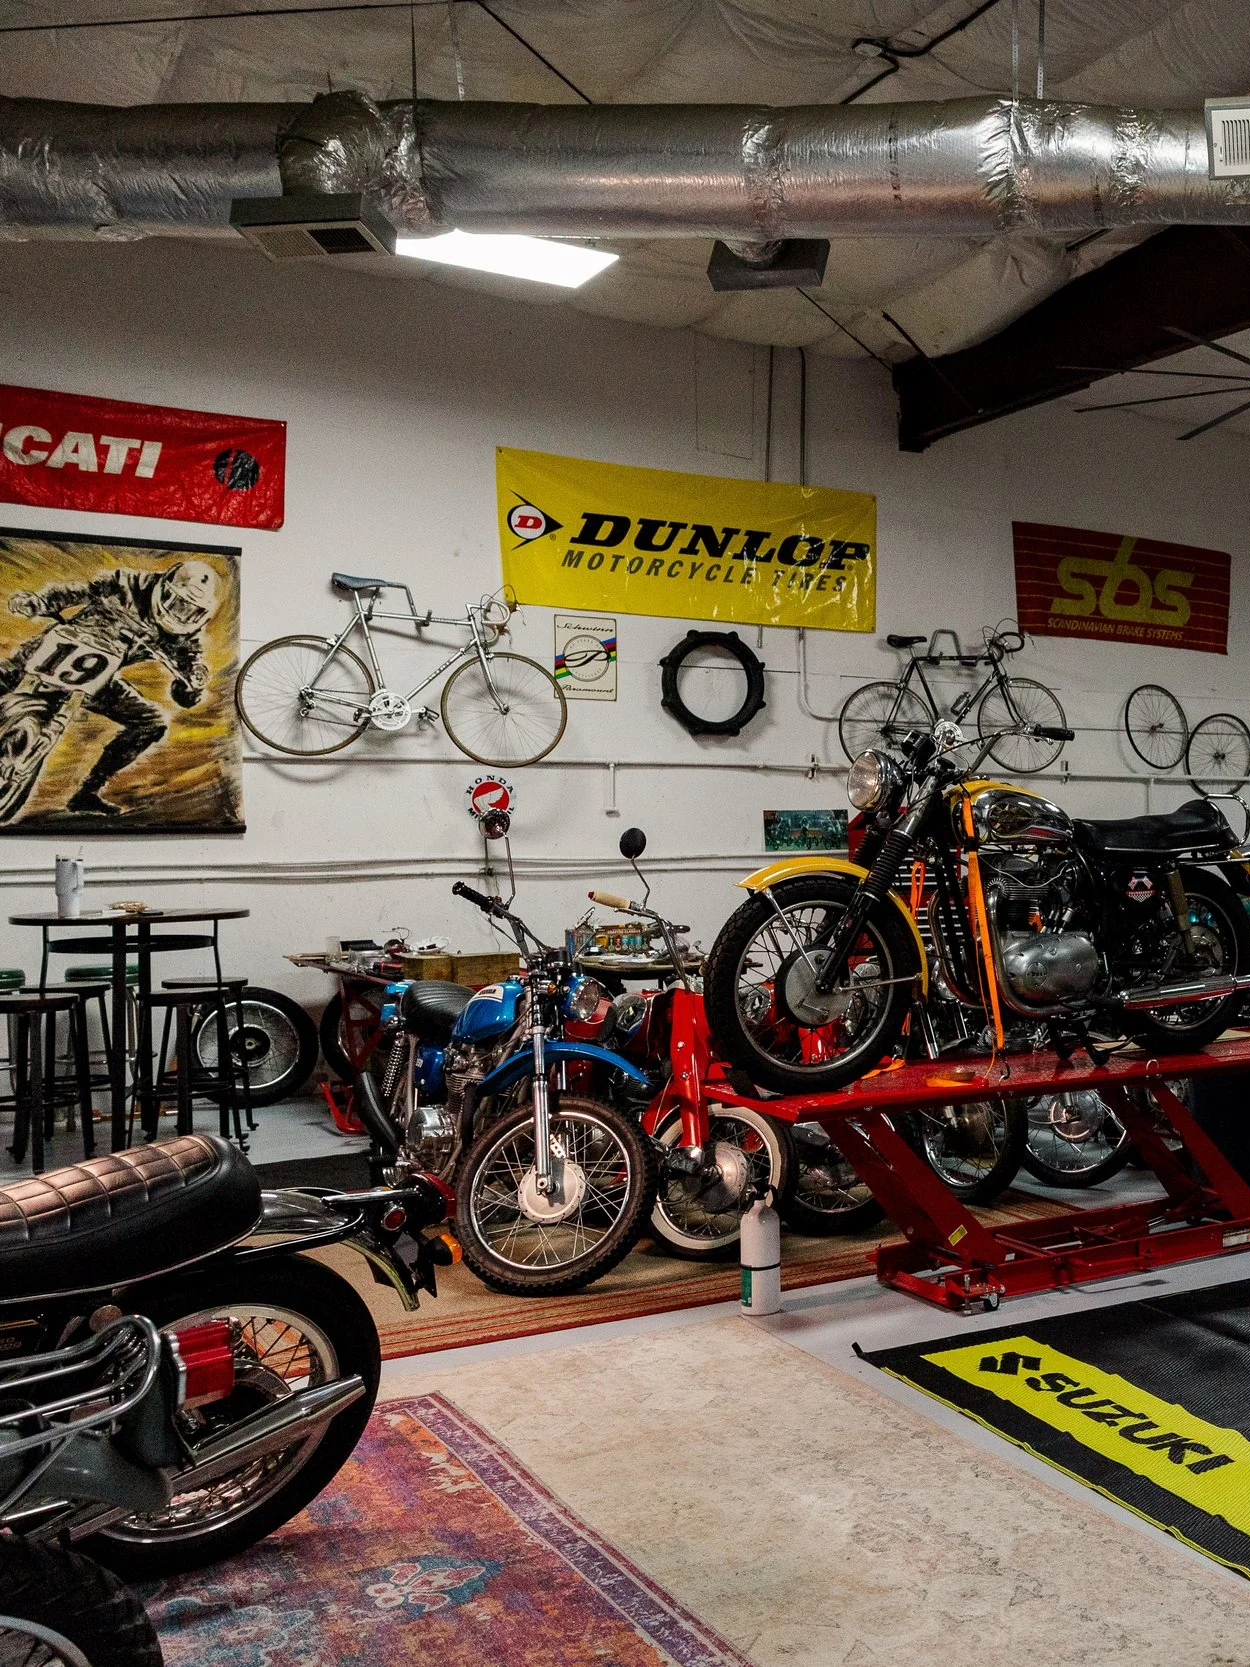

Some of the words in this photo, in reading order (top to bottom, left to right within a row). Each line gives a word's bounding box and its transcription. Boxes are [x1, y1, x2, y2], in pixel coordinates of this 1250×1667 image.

[0, 422, 163, 479] CATI
[569, 511, 871, 572] DUNLOP
[560, 549, 756, 586] MOTORCYCLE
[772, 568, 848, 593] TIRES
[556, 622, 614, 633] Schwinn
[1047, 617, 1115, 635] SCANDINAVIAN
[1116, 624, 1145, 638] BRAKE
[1146, 627, 1204, 642] SYSTEMS
[33, 642, 110, 686] 19
[562, 684, 614, 693] Paramount
[465, 774, 514, 796] HONDA
[1024, 1370, 1233, 1476] SUZUKI
